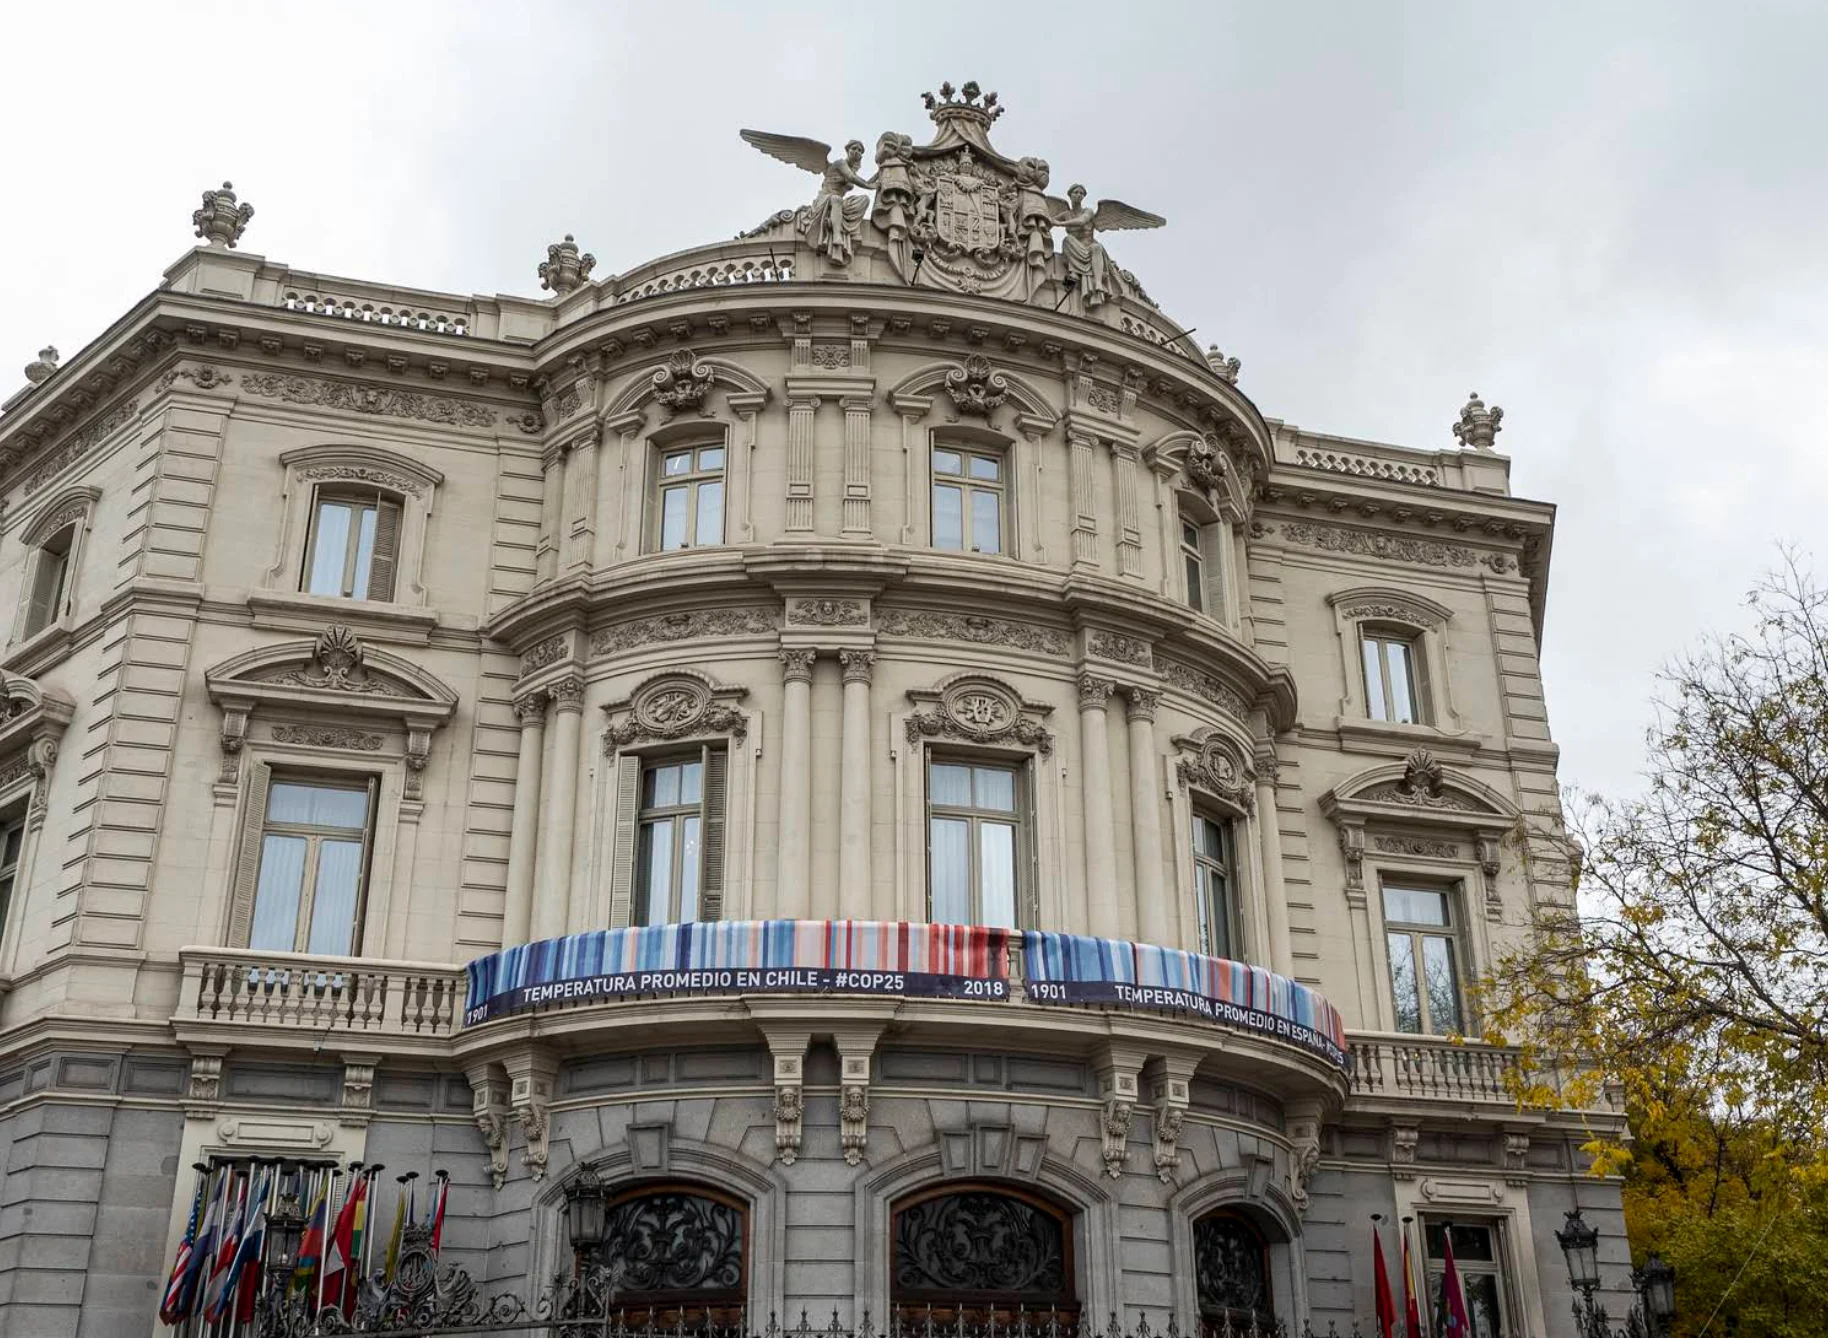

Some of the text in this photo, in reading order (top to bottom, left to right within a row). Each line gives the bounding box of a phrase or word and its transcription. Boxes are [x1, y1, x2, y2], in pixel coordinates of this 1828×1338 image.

[467, 1004, 488, 1025] 1901
[523, 974, 636, 1003] TEMPERATURA
[640, 971, 731, 990] PROMEDIO
[736, 971, 760, 988] EN
[766, 971, 818, 987] CHILE
[835, 972, 904, 990] #COP25
[964, 980, 1004, 996] 2018
[1031, 984, 1066, 1000] 1901
[1114, 985, 1212, 1016] TEMPERATURA
[1215, 1003, 1275, 1031] PROMEDIO
[1277, 1020, 1291, 1036] EN
